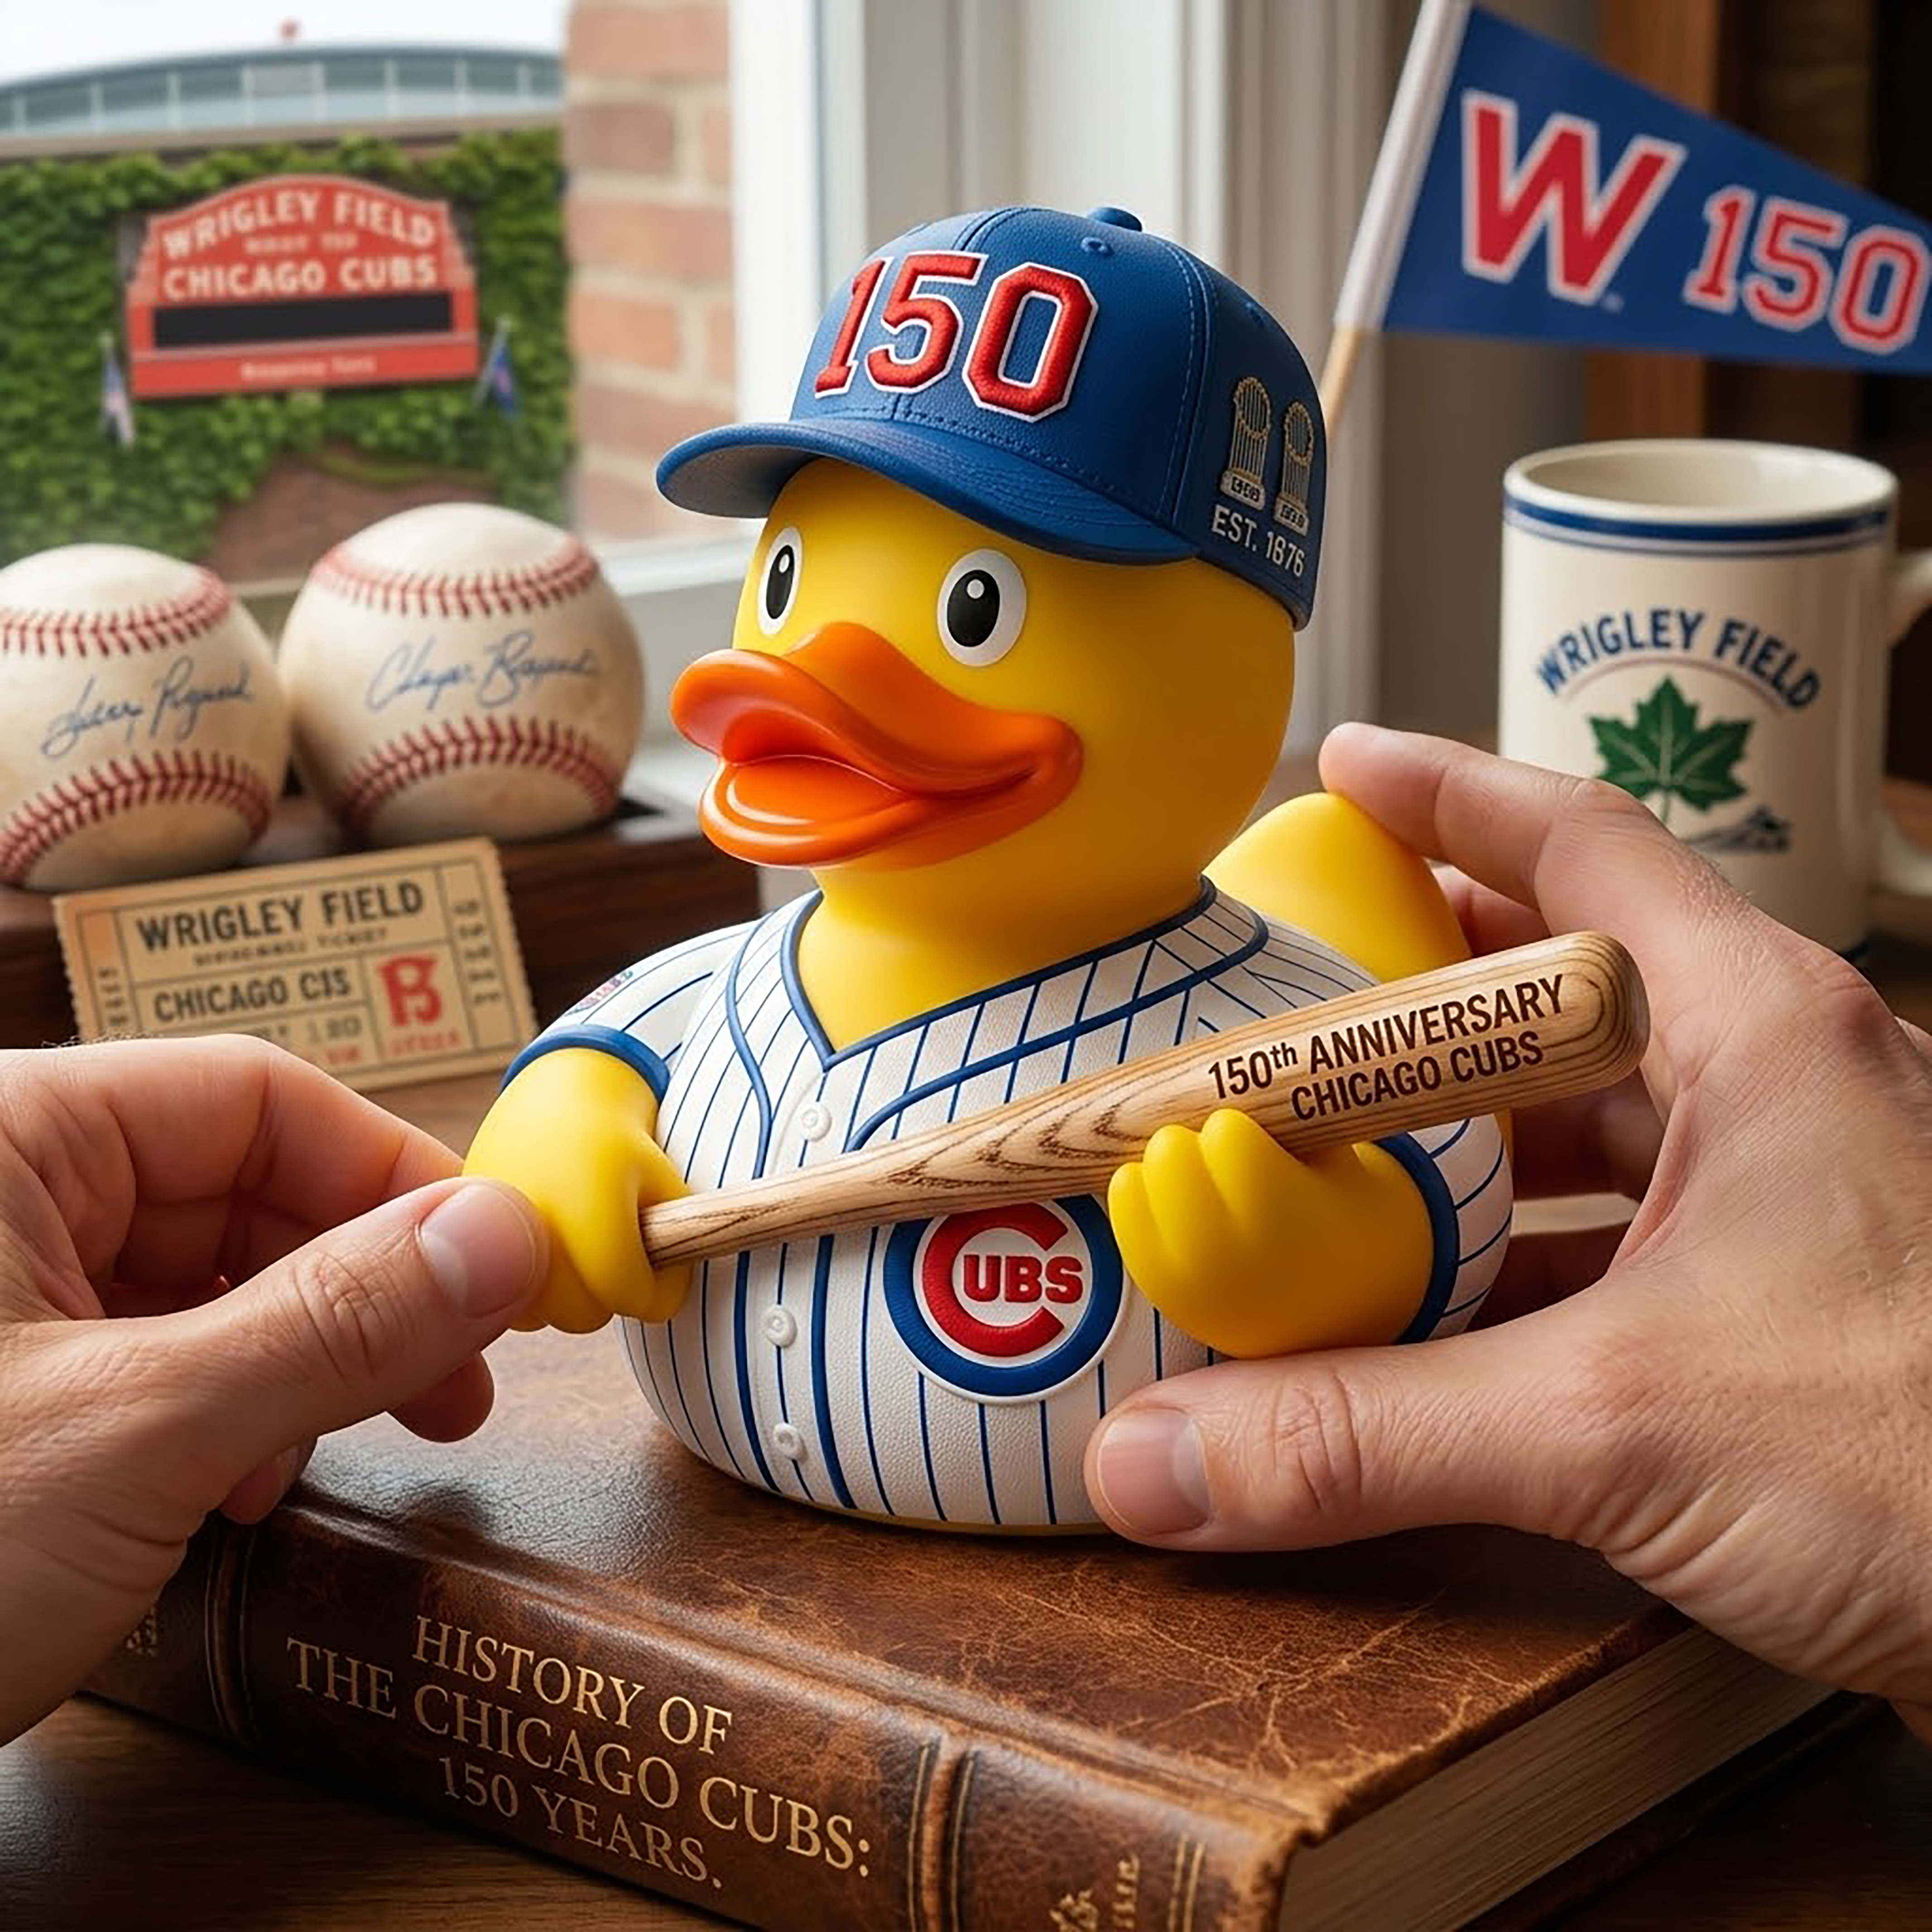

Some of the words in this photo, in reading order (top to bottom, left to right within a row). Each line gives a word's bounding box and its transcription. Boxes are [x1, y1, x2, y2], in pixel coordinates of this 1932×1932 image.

[163, 188, 322, 260] WRIGLEY
[334, 192, 435, 246] FIELD
[1462, 90, 1687, 307] W
[1682, 185, 1932, 356] 150
[163, 261, 326, 300] CHICAGO
[339, 255, 437, 290] CUBS
[815, 250, 1098, 423] 150
[1212, 504, 1257, 551] EST.
[1266, 531, 1305, 577] 1876
[1538, 609, 1703, 694] WRIGLEY
[1715, 618, 1821, 710] FIELD
[138, 896, 303, 952] WRIGLEY
[321, 883, 423, 926] FIELD
[155, 977, 288, 1022] CHICAGO
[1208, 1042, 1298, 1099] 150th
[1310, 974, 1563, 1075] ANNIVERSARY
[1292, 1056, 1441, 1121] CHICAGO
[1451, 1031, 1542, 1082] CUBS
[412, 1615, 644, 1728] HISTORY
[659, 1697, 732, 1755] OF
[286, 1637, 396, 1719] THE
[415, 1684, 679, 1809] CHICAGO
[700, 1776, 870, 1878] CUBS:
[439, 1757, 518, 1817] 150
[532, 1785, 721, 1889] YEARS.
